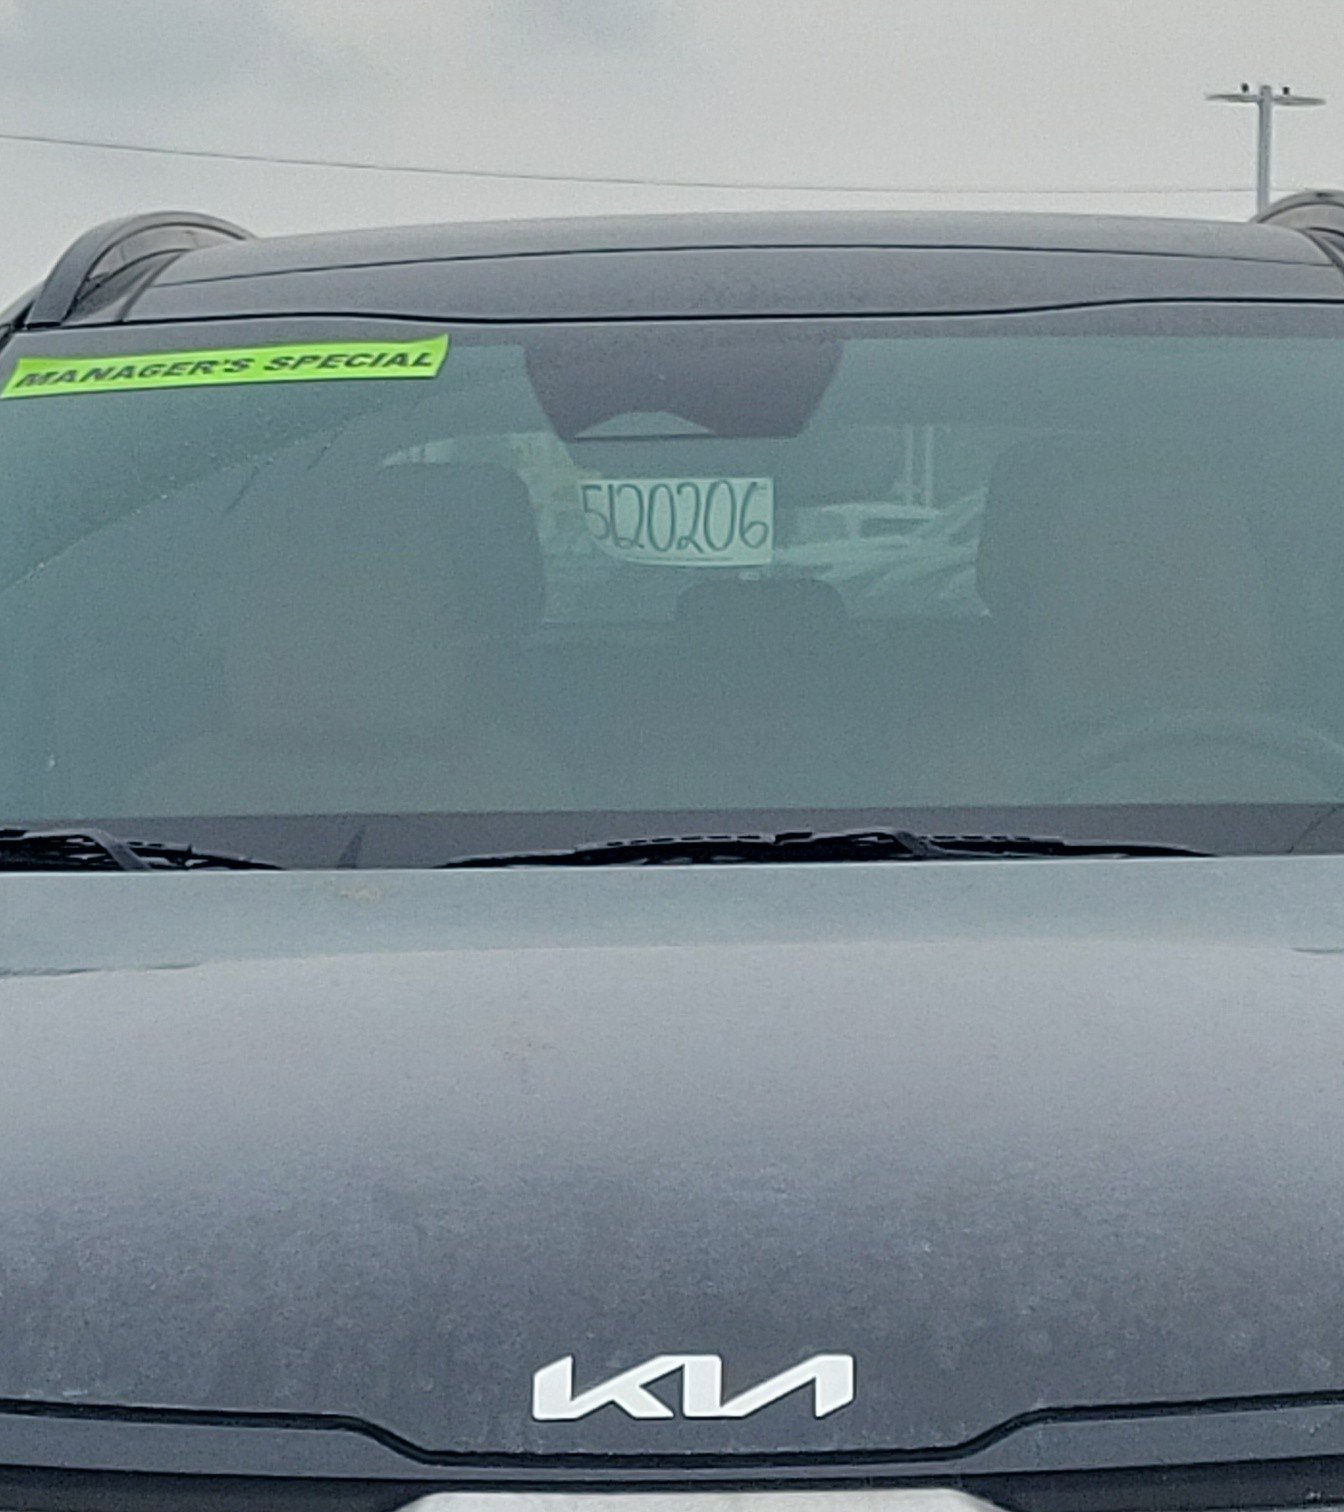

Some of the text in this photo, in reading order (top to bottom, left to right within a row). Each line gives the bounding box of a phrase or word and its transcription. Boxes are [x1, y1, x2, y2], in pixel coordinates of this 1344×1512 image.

[14, 350, 434, 389] MANAGER'S SPECIAL
[532, 1353, 854, 1421] KIA
